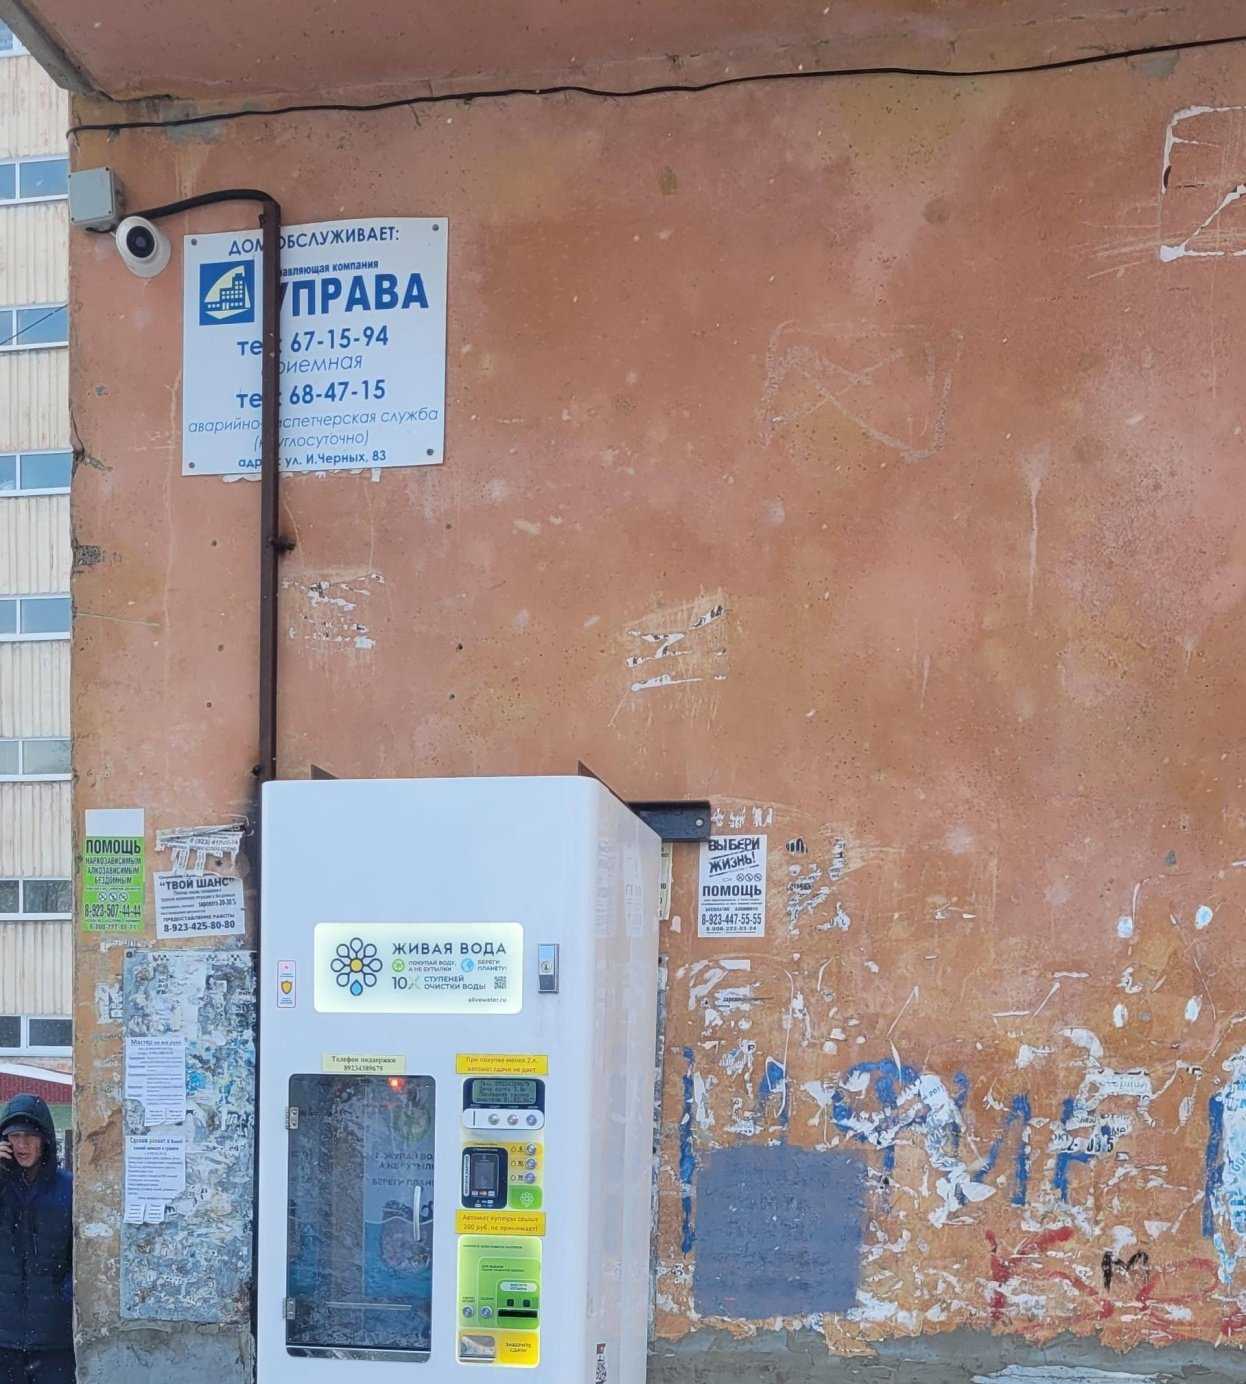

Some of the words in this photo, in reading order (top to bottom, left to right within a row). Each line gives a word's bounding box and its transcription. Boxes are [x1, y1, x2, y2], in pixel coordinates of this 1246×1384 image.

[332, 260, 379, 272] компания
[236, 339, 282, 356] те:
[290, 325, 389, 353] 67-15-94
[236, 389, 282, 409] те:
[289, 379, 386, 404] 68-47-15
[380, 407, 439, 424] служба
[285, 456, 302, 468] ул.
[372, 450, 386, 461] 83
[86, 839, 141, 855] ПОМОЩЬ
[708, 837, 760, 851] ВЫБЕРИ
[709, 851, 757, 873] ЖИЗНЬ!
[702, 885, 762, 898] ПОМОЩЬ
[163, 920, 236, 932] 8-923-425-80-80
[701, 913, 762, 926] 8-923-447-55-55
[392, 942, 453, 955] ЖИВАЯ
[460, 942, 507, 957] ВОДА
[462, 983, 486, 991] ВОДЫ
